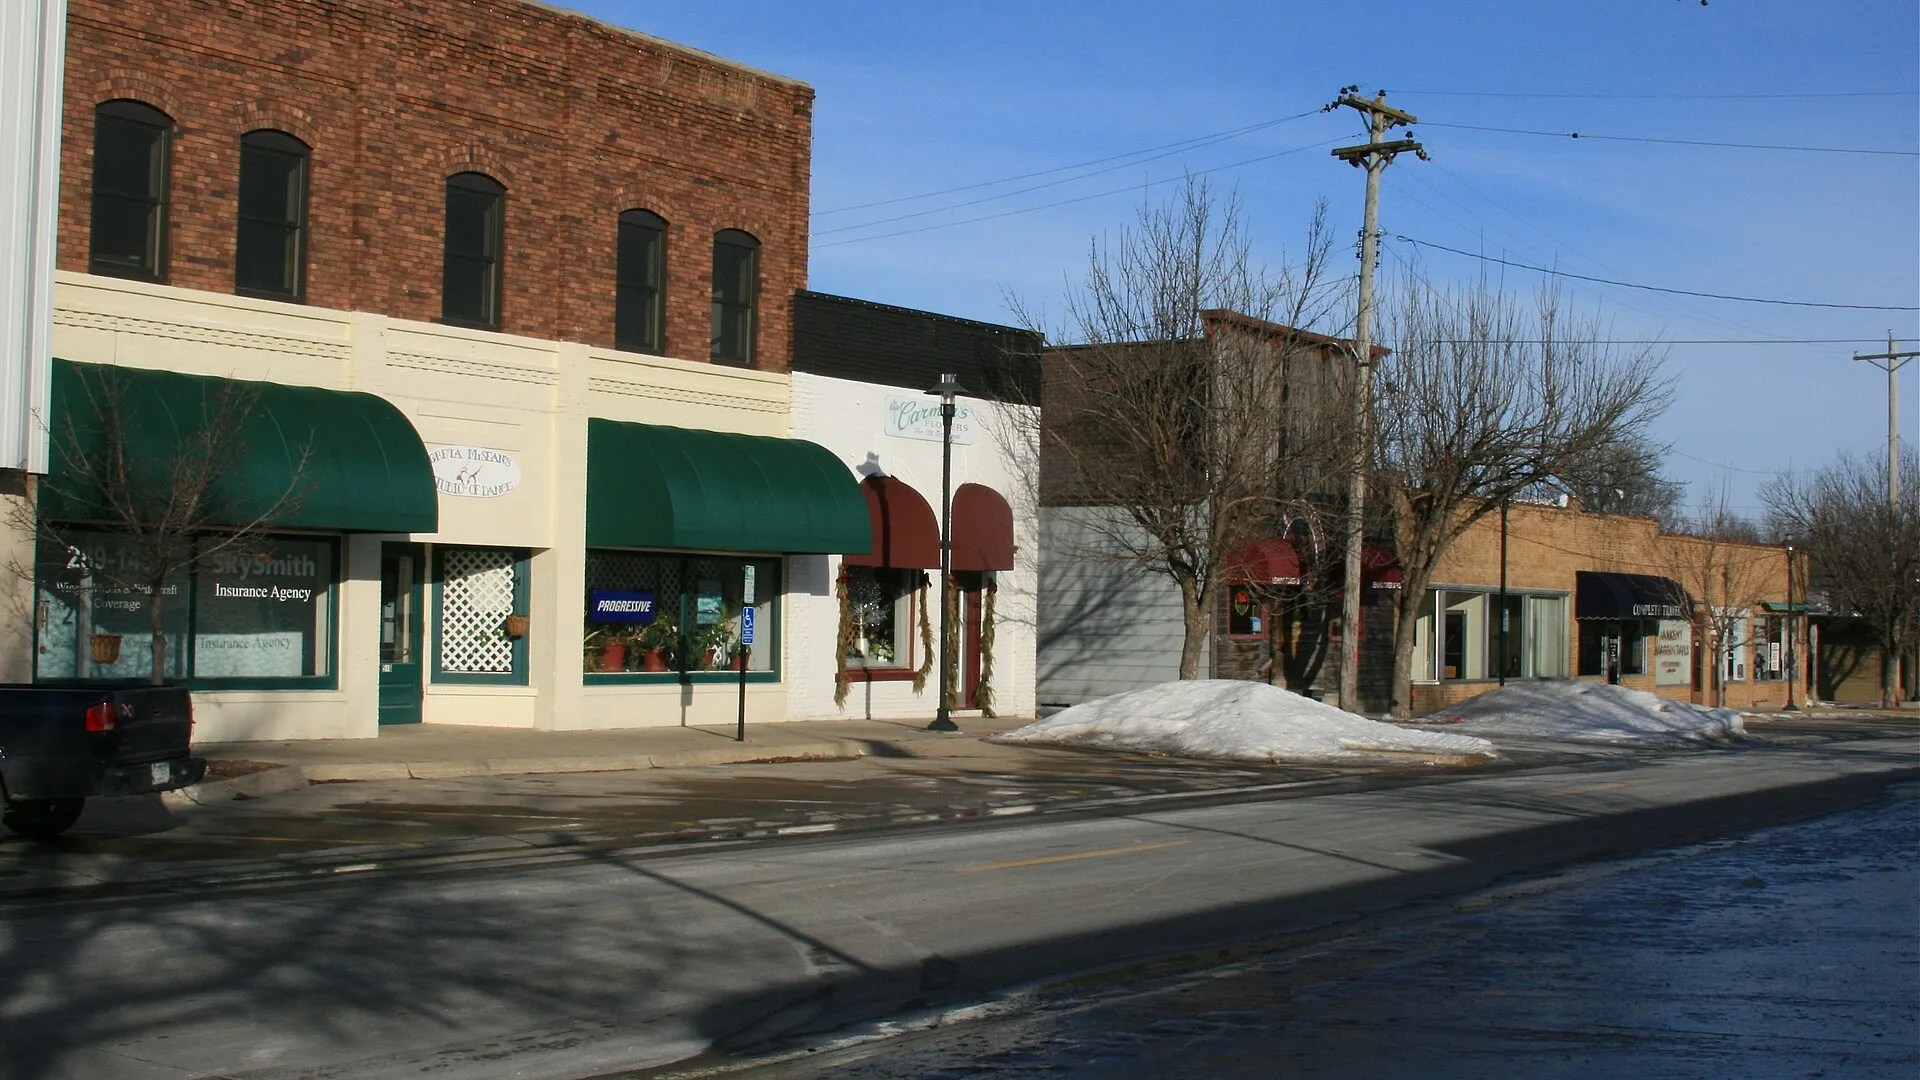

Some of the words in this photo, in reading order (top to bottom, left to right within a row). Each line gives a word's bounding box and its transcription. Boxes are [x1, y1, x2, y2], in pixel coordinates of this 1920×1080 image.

[482, 481, 513, 497] DANCE
[215, 583, 268, 598] Insurance
[270, 585, 312, 602] Agency
[94, 597, 141, 611] Coverage
[597, 600, 652, 613] PROGRESSIVE
